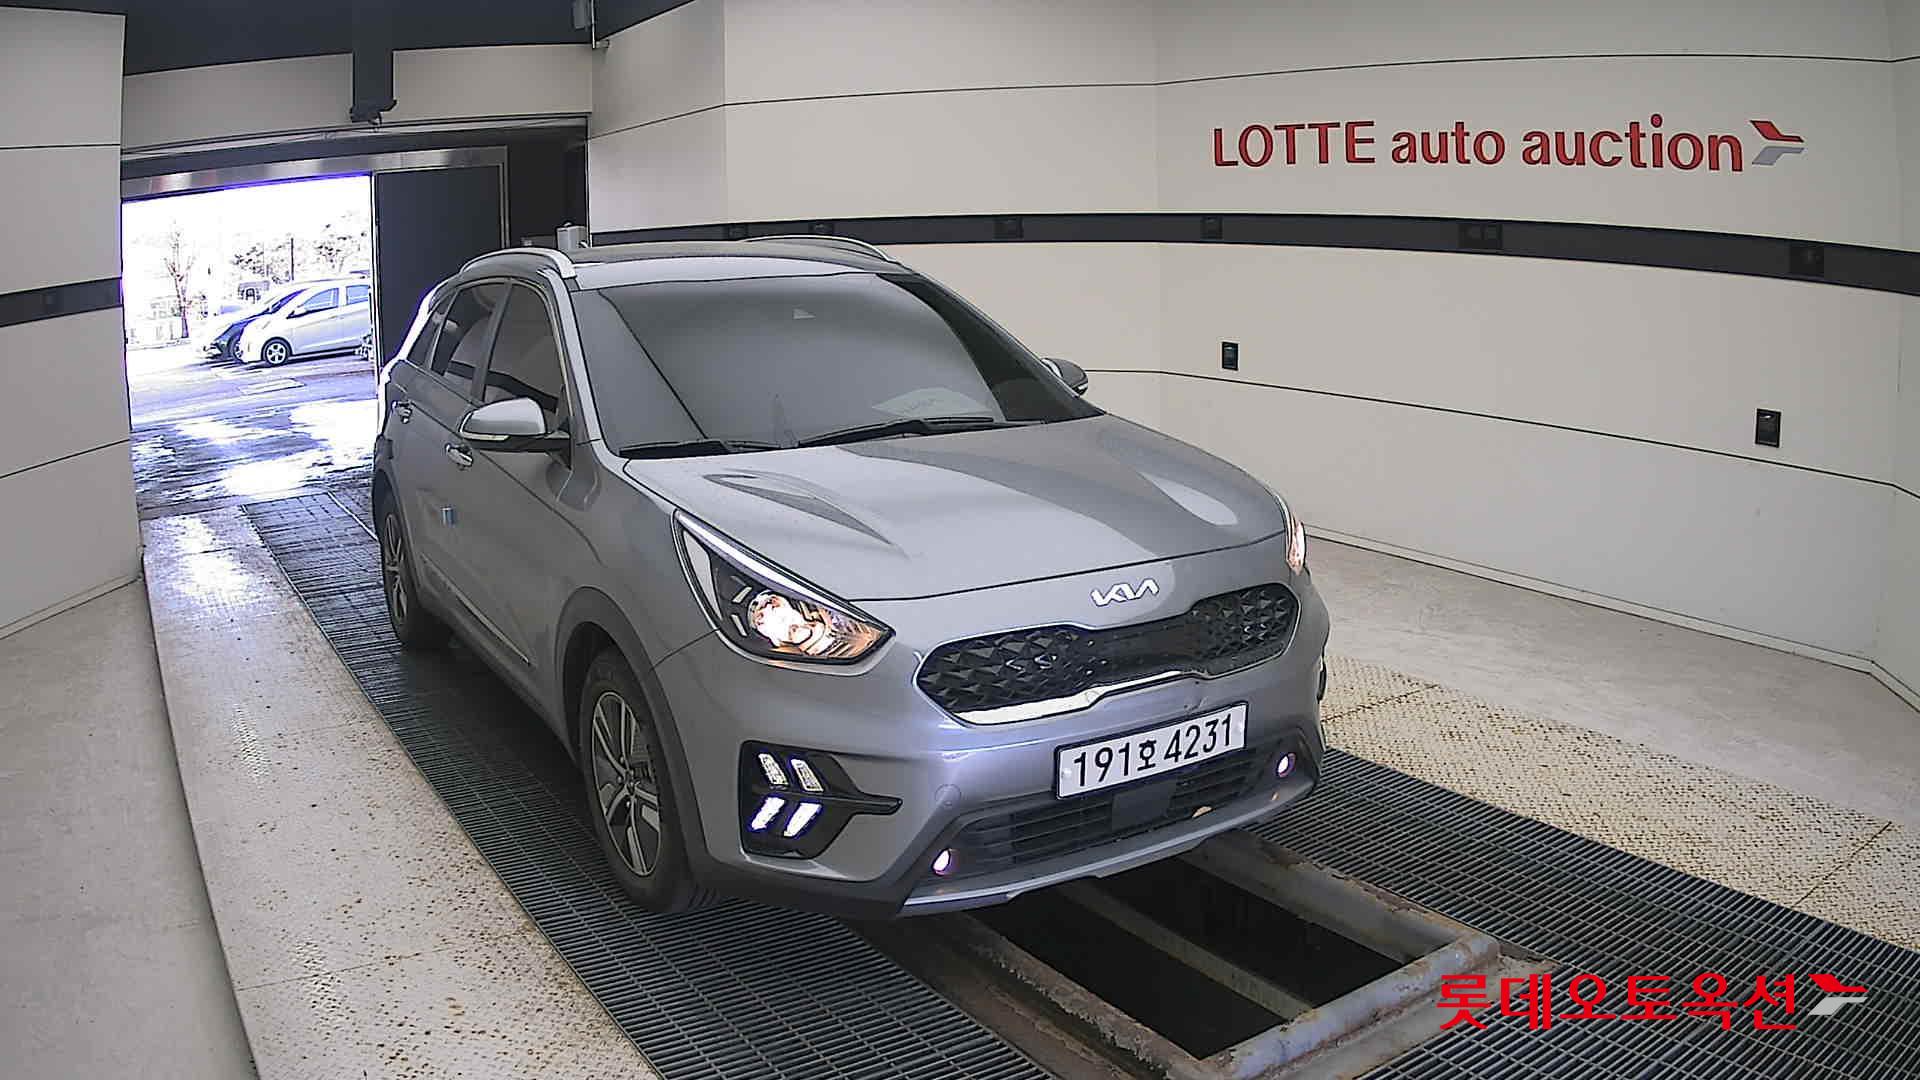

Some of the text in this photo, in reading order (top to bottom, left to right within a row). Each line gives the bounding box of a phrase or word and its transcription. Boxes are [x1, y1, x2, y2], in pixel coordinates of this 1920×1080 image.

[1213, 114, 1744, 173] LOTTE auto auction
[1091, 578, 1159, 607] KIA
[1164, 713, 1232, 763] 4231
